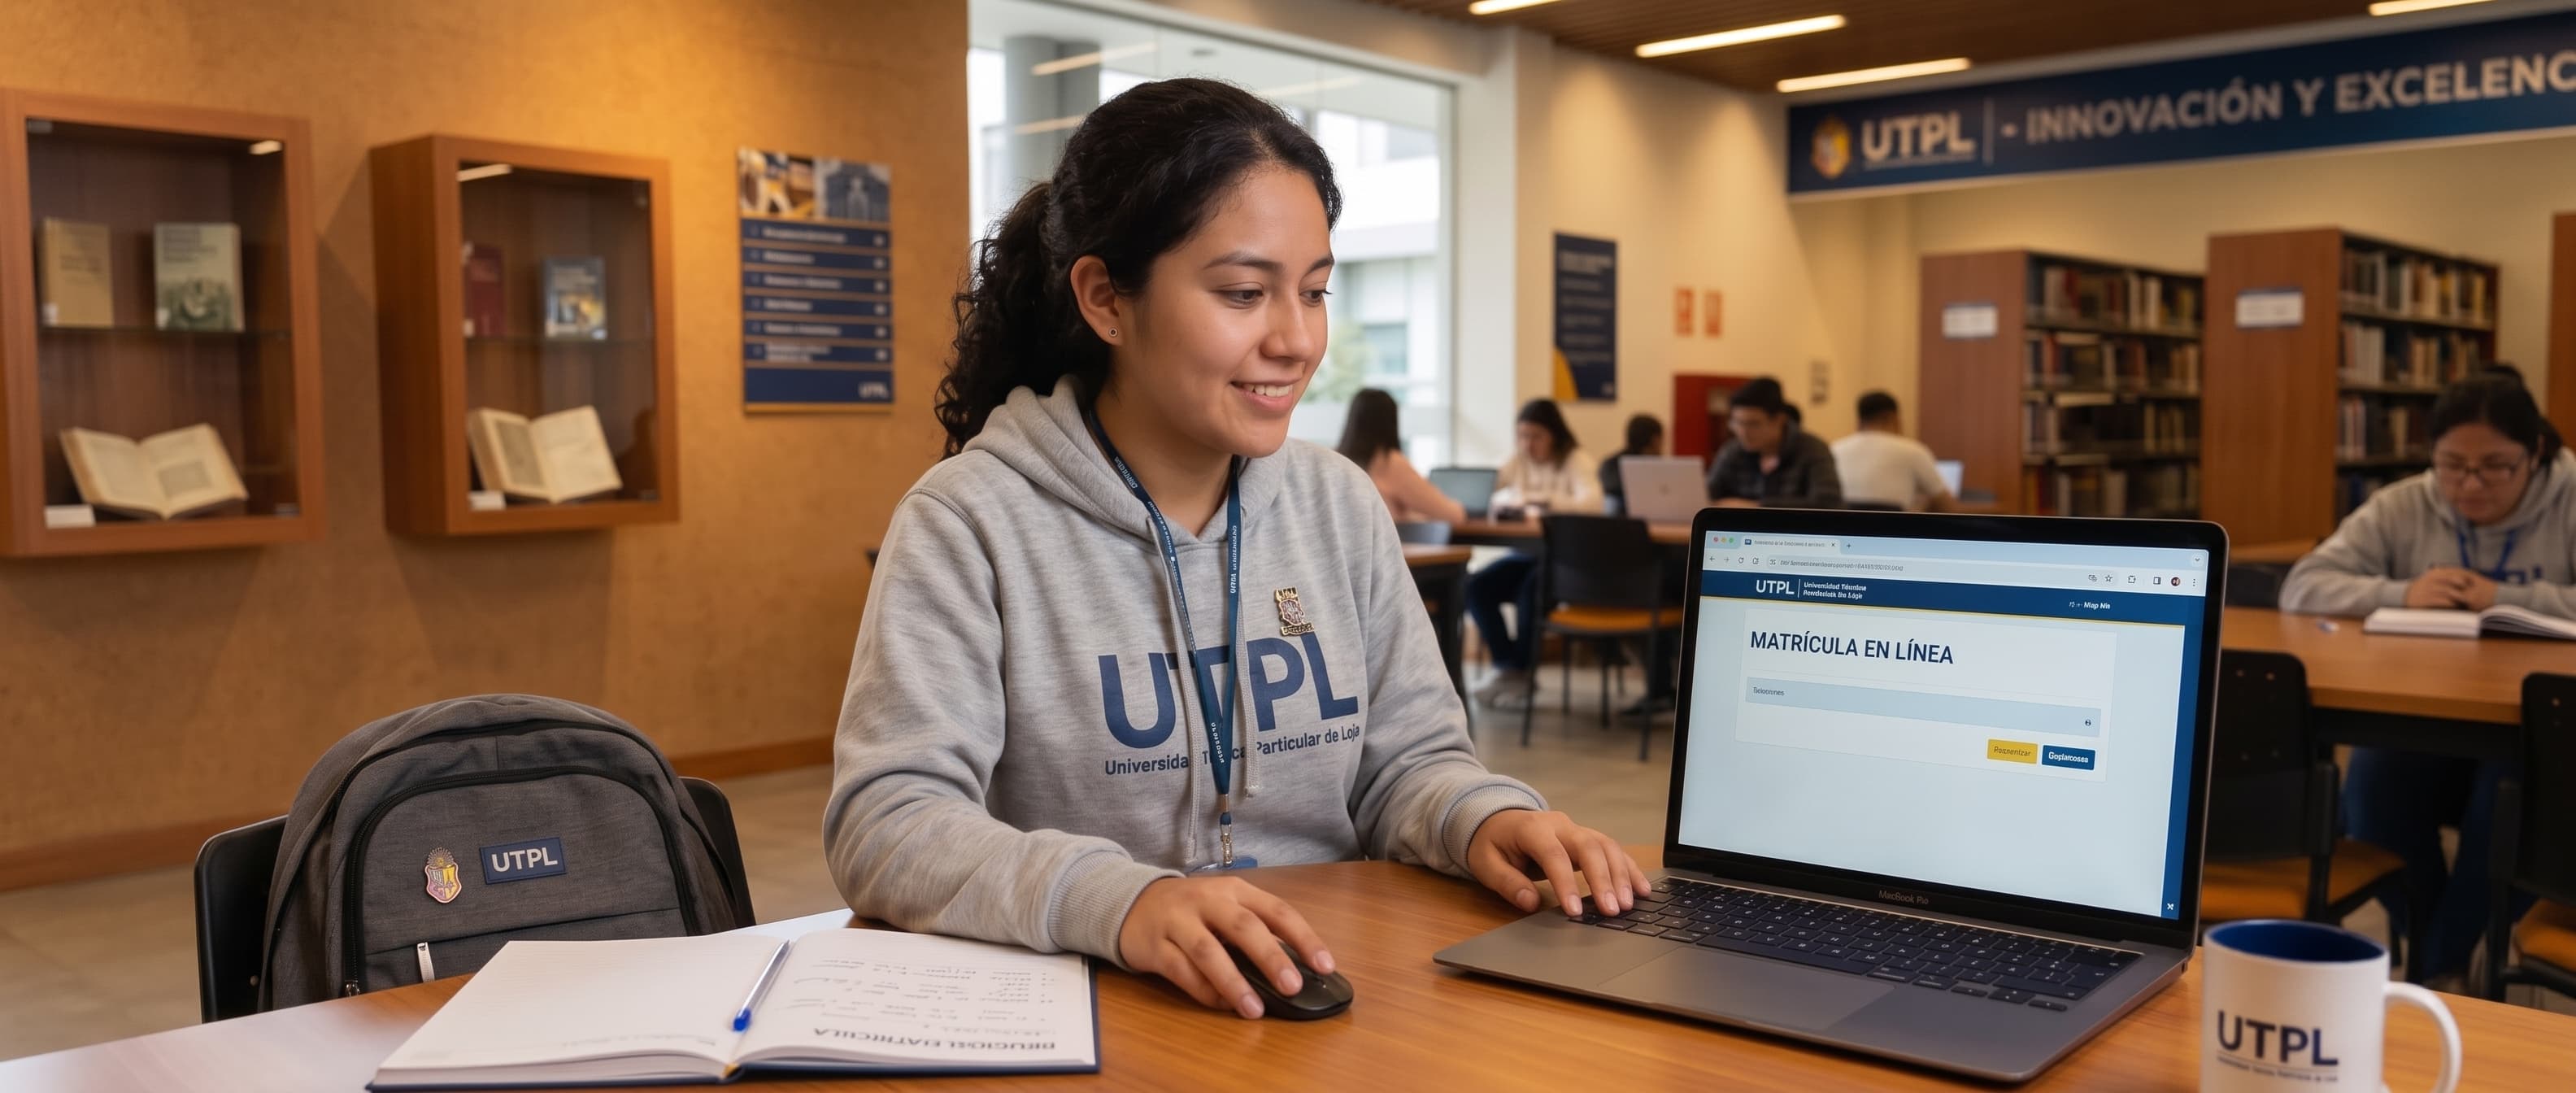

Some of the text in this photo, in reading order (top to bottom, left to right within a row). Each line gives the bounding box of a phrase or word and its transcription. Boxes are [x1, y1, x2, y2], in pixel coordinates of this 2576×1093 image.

[1861, 109, 1976, 162] UTPL
[2026, 78, 2282, 145] INNOVACIÓN
[2292, 78, 2324, 116] Y
[2334, 50, 2576, 114] EXCELENC
[1756, 579, 1795, 594] UTPL
[1750, 630, 1954, 664] MATRÍCULA EN LÍNEA
[1098, 632, 1360, 749] UTPL
[1105, 753, 1190, 775] Universida
[1325, 728, 1338, 744] de
[1341, 723, 1360, 742] Loja
[491, 847, 559, 873] UTPL
[1878, 890, 1915, 904] MacBook
[2217, 1010, 2339, 1066] UTPL
